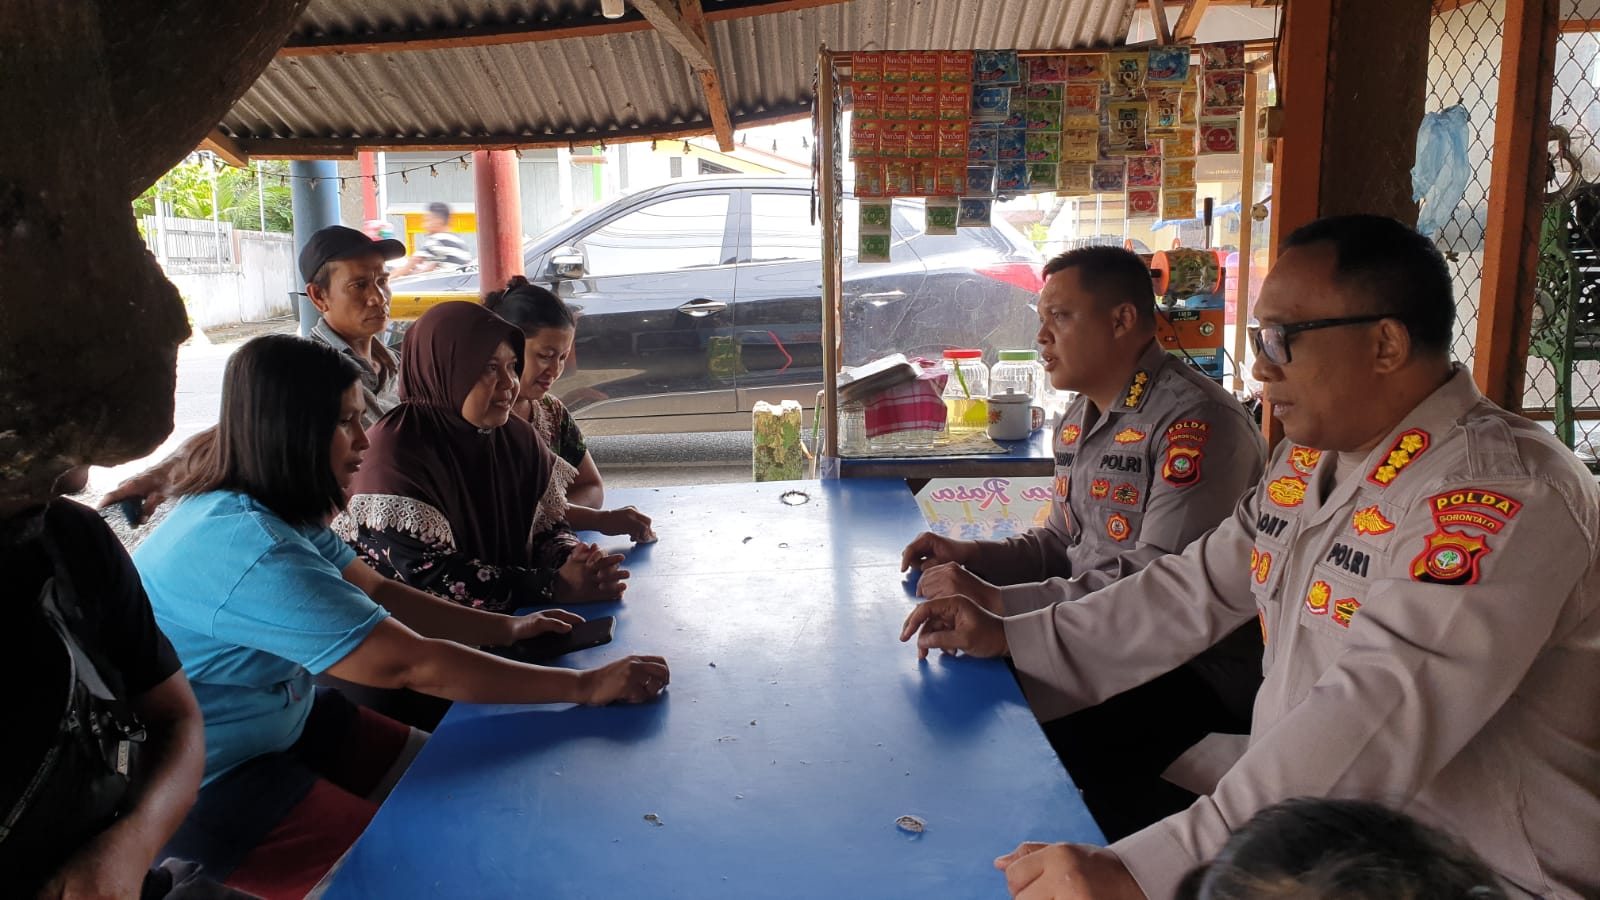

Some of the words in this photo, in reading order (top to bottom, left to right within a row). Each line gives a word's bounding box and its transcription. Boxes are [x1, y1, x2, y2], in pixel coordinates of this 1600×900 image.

[1117, 71, 1141, 81] TOP
[1100, 454, 1142, 473] POLRI
[1436, 492, 1511, 514] POLDA
[1439, 513, 1495, 529] GORONTALO
[1326, 542, 1371, 578] POLRI
